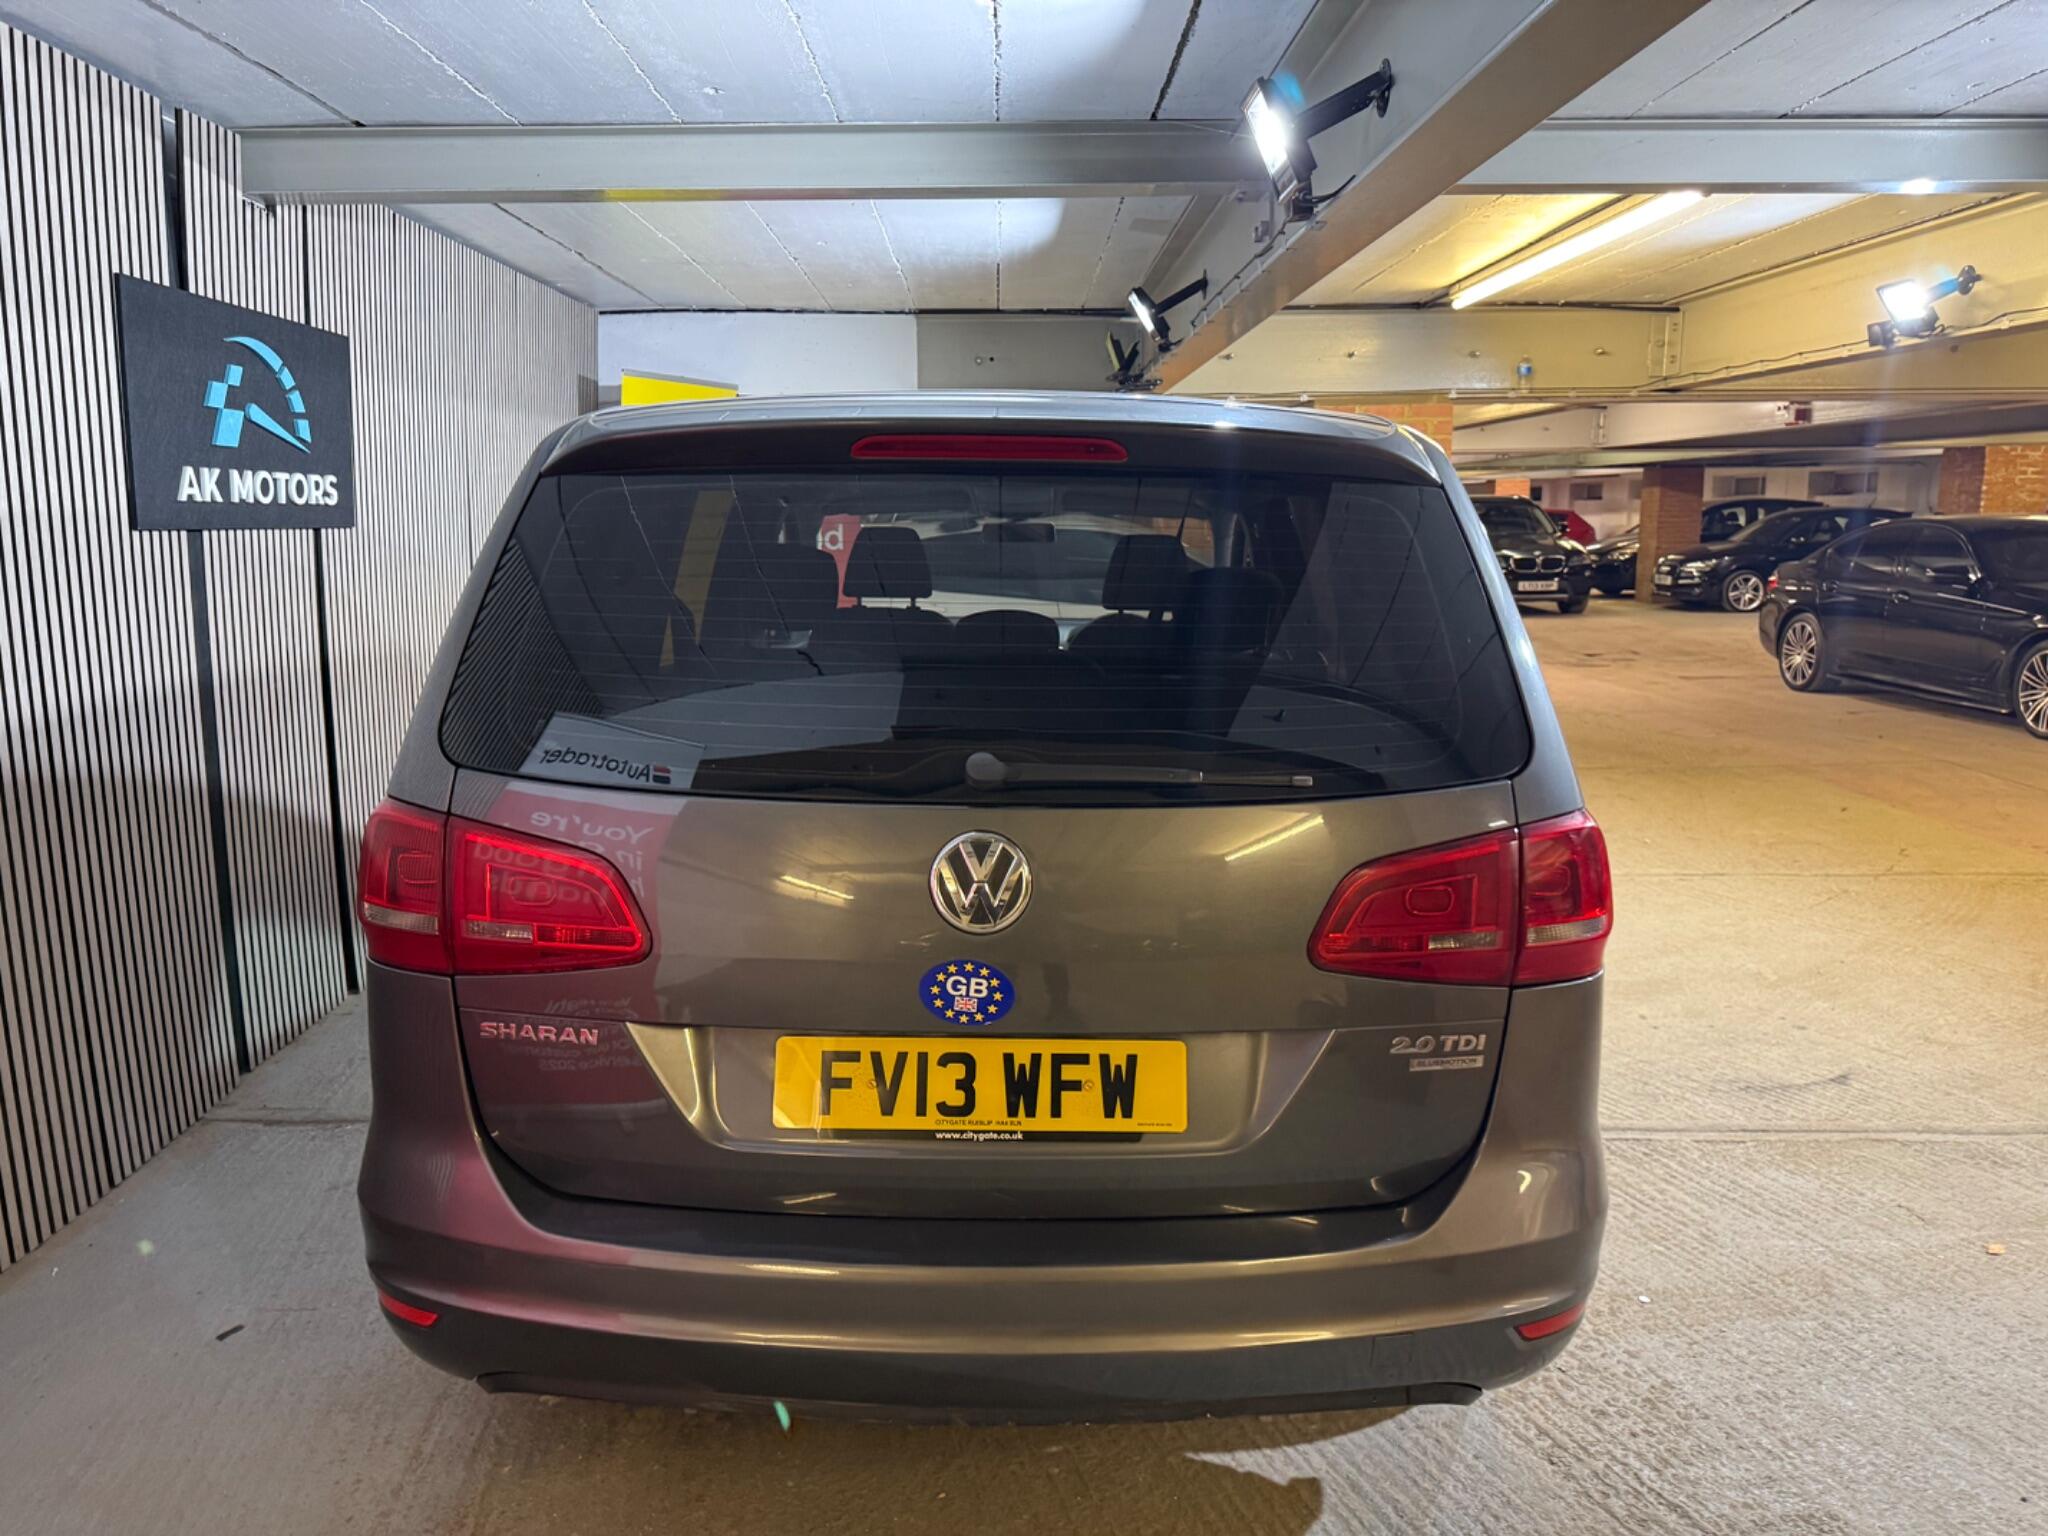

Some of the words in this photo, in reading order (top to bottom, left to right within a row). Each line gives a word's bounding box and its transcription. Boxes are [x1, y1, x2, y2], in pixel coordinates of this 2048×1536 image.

[177, 466, 223, 502] AK
[229, 468, 338, 505] MOTORS
[946, 975, 989, 998] GB
[479, 1021, 598, 1045] SHARAN
[1440, 1034, 1487, 1052] TDI
[820, 1050, 977, 1117] FV13
[1002, 1053, 1138, 1119] WFW
[935, 1130, 1024, 1141] www.citygate.co.uk
